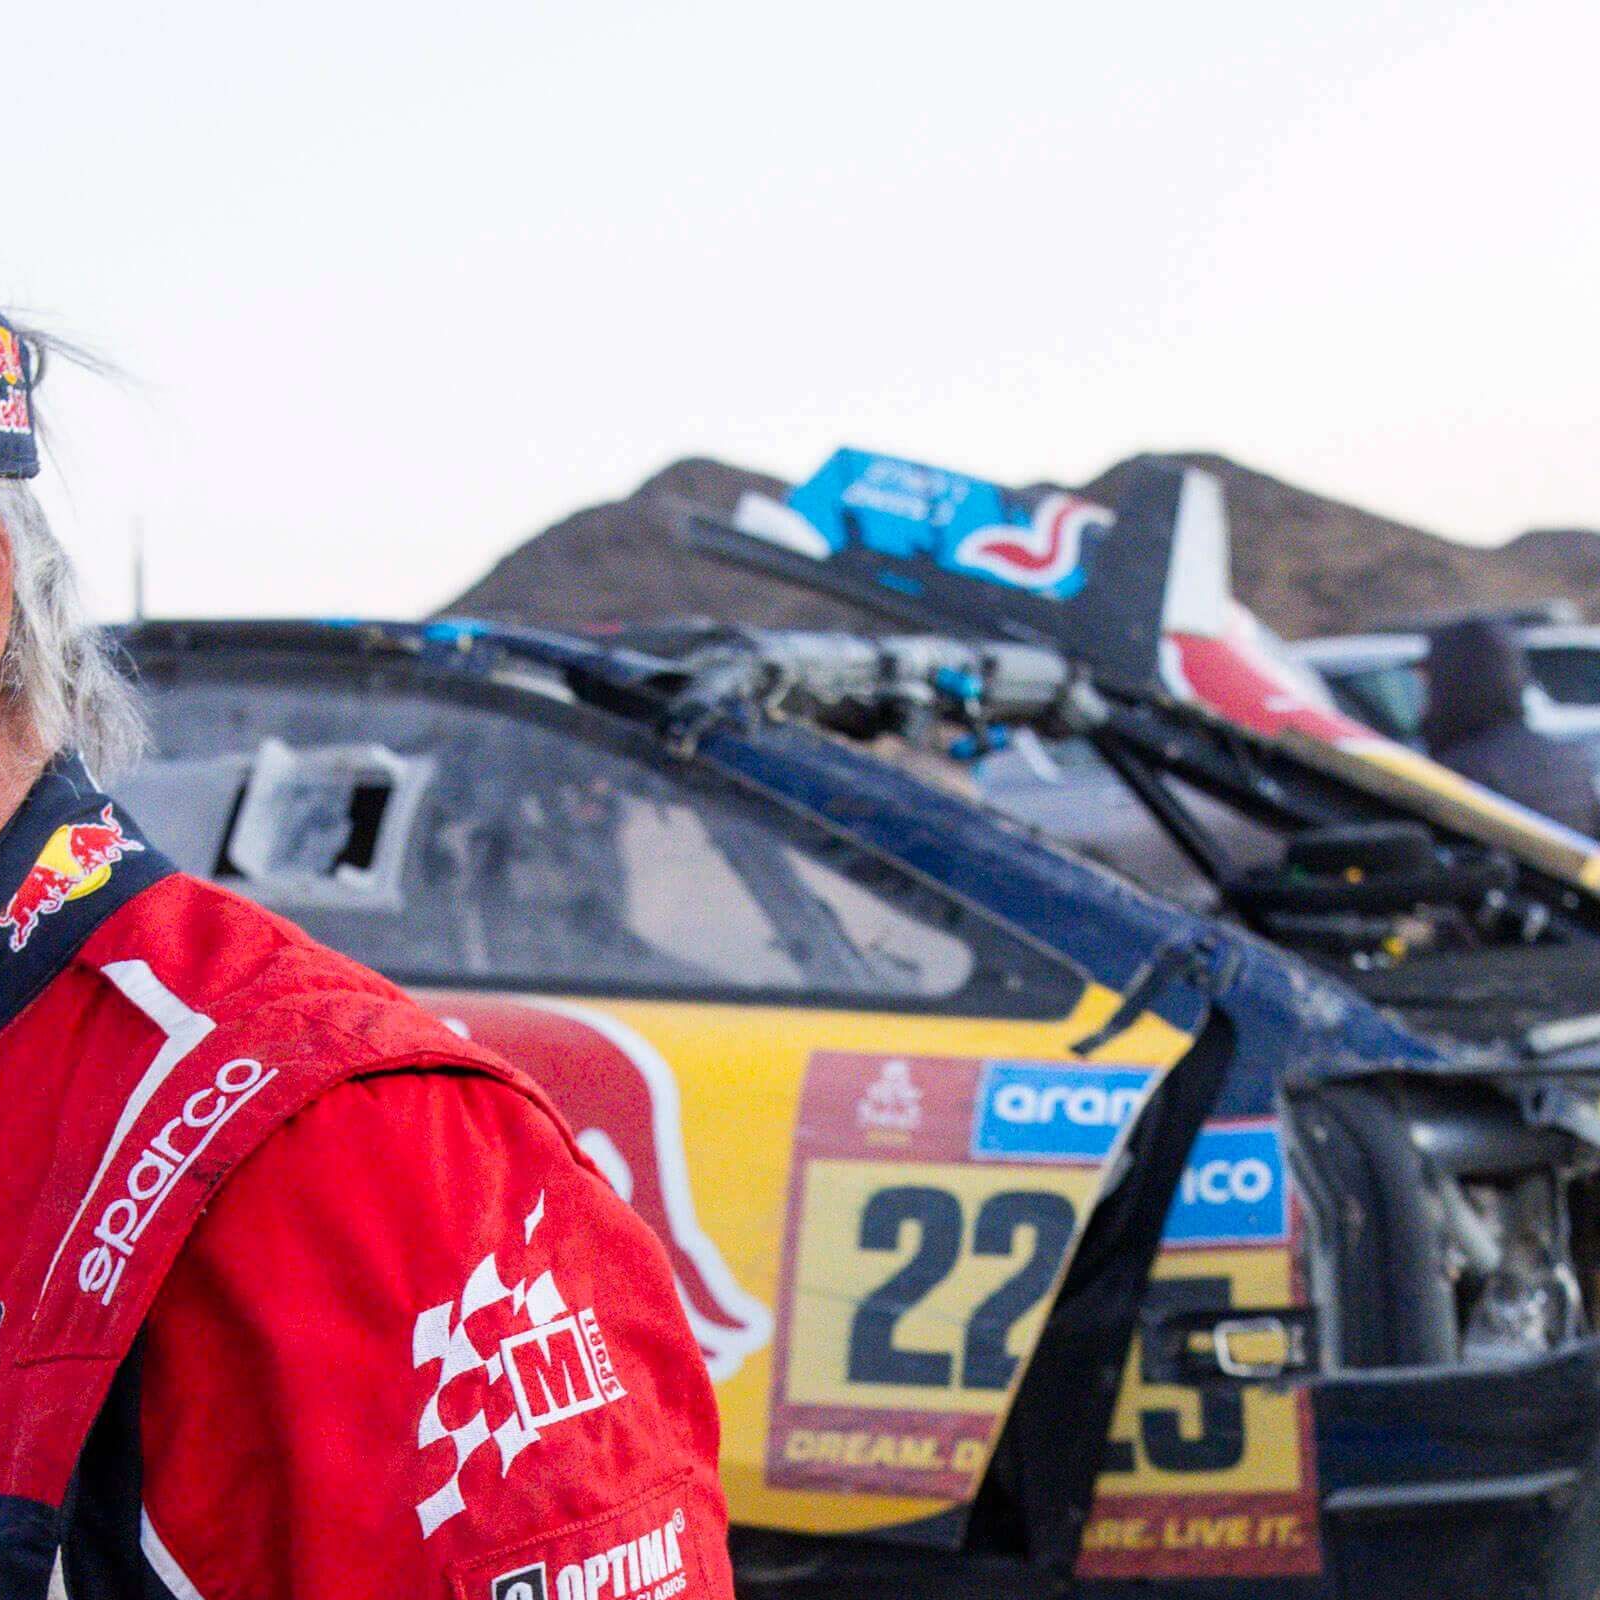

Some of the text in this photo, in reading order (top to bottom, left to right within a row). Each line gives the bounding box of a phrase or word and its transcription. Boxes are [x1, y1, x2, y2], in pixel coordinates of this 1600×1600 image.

[78, 1057, 264, 1297] sparco
[510, 1327, 594, 1418] M
[583, 1316, 622, 1395] SPORT
[1162, 1515, 1250, 1549] LIVE
